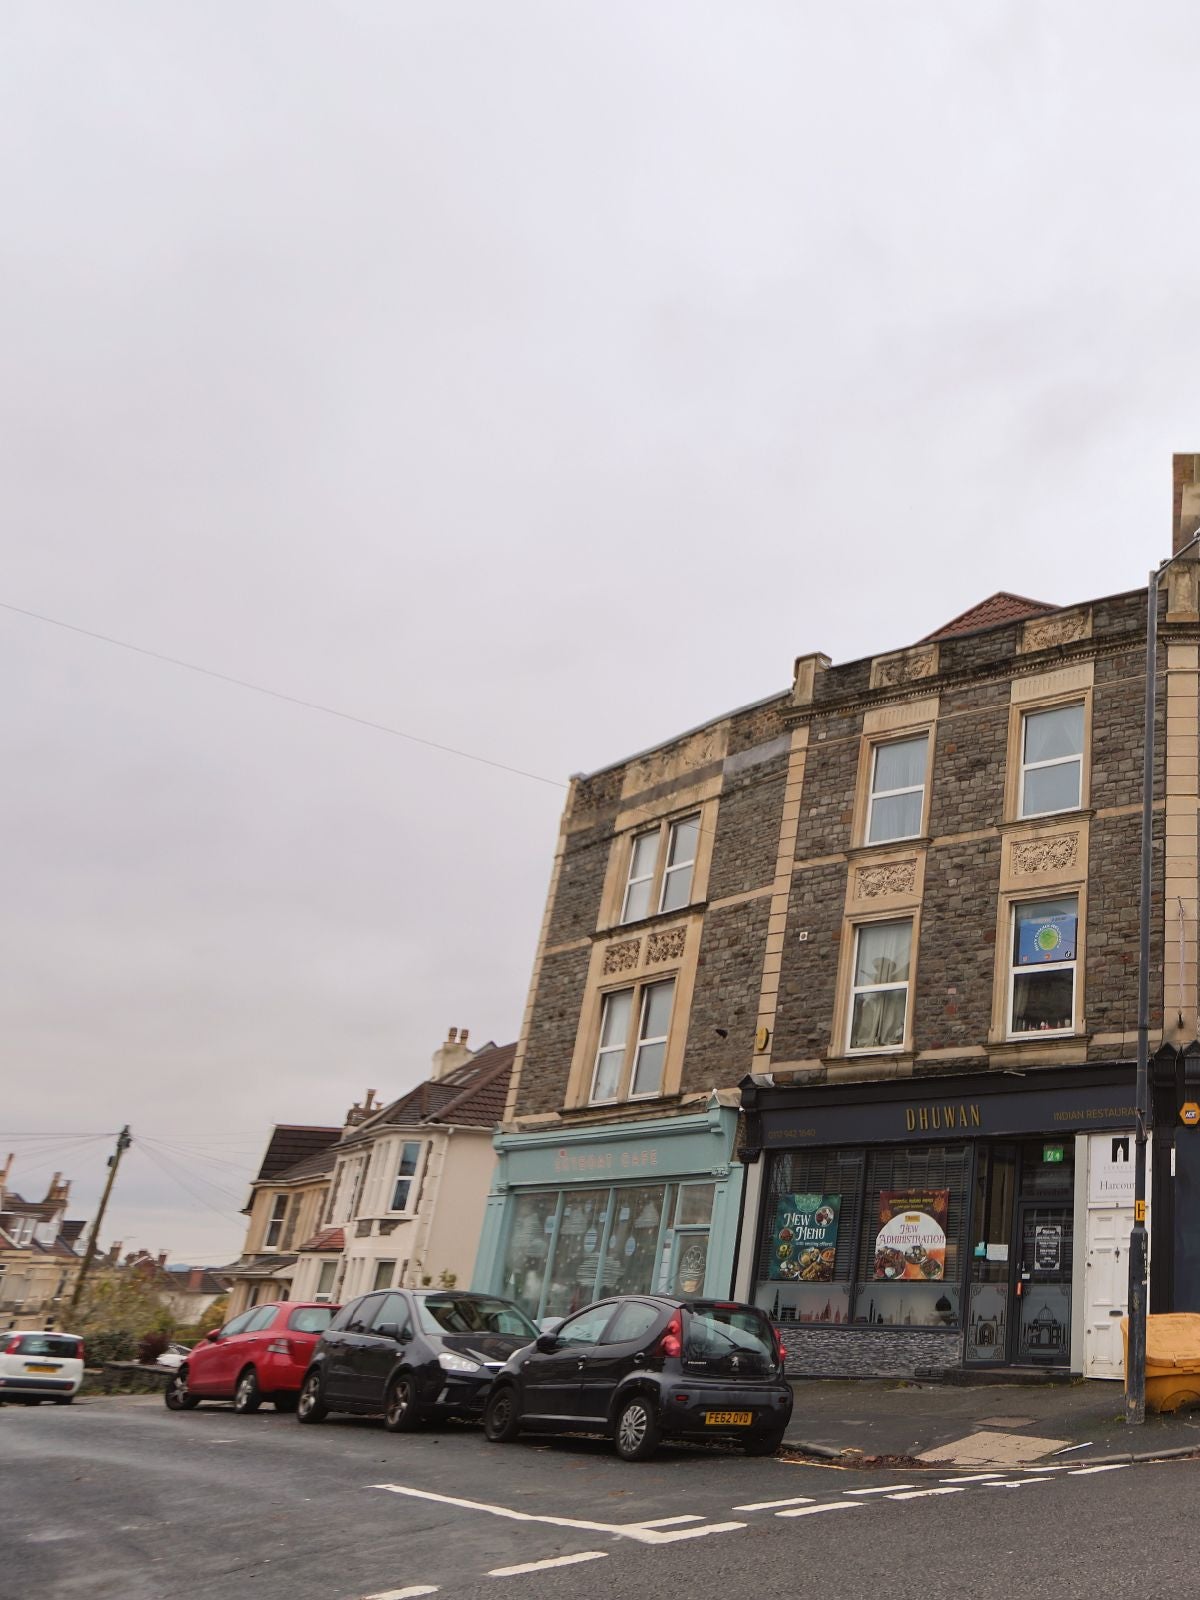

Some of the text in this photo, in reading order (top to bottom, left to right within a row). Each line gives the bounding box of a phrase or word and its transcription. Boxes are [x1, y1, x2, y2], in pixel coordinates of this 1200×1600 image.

[905, 1104, 981, 1131] DHUWAN
[1054, 1107, 1138, 1120] INDIAN RESTAURA
[1100, 1180, 1136, 1191] Harcour
[783, 1212, 812, 1227] NEW
[795, 1226, 826, 1241] MENU
[879, 1234, 945, 1245] ADMINISTRATION
[708, 1413, 732, 1424] FE62
